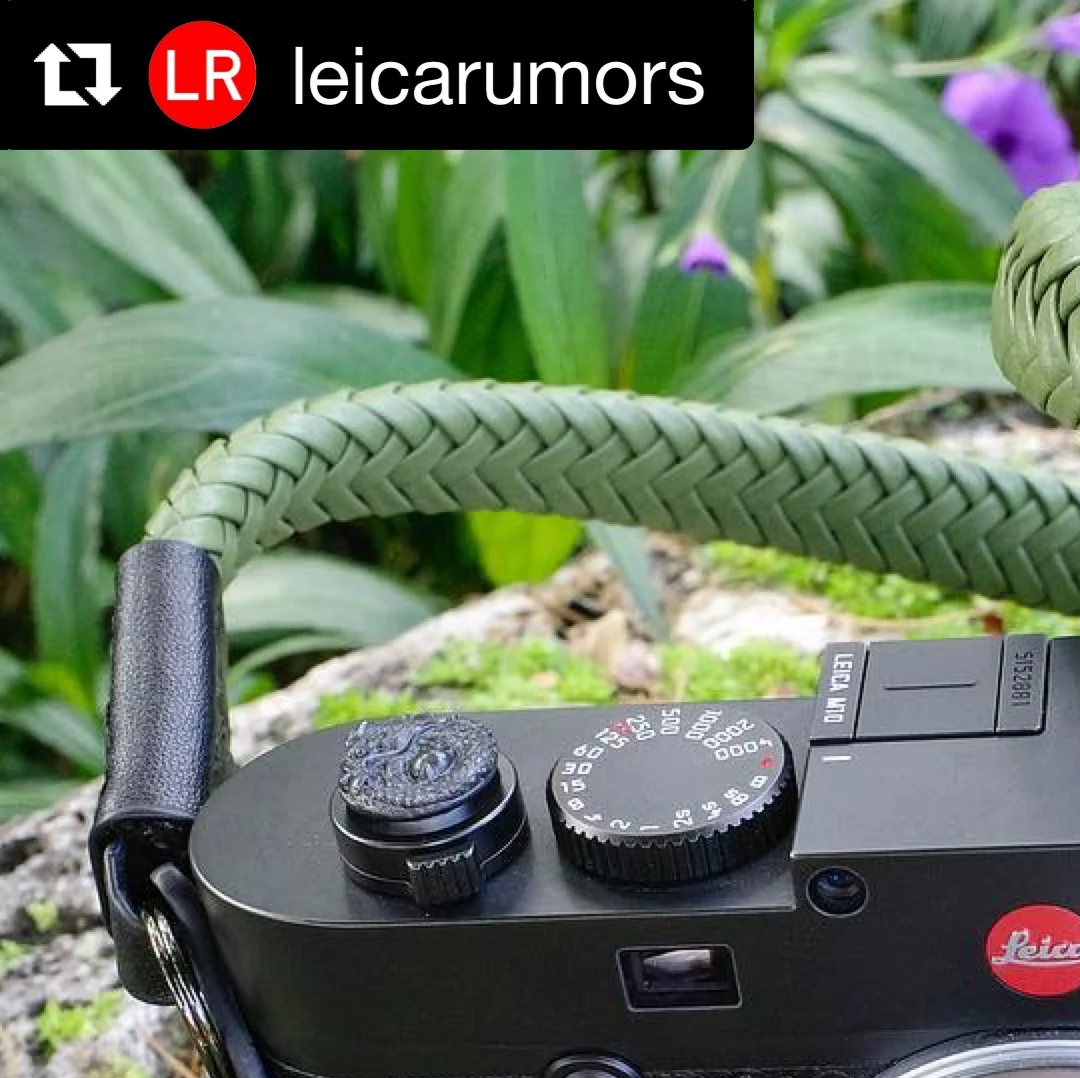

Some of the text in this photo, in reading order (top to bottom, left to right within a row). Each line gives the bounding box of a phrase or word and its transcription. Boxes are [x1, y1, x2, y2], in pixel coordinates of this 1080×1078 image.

[823, 653, 854, 723] LEICA M10
[626, 714, 656, 741] 250
[660, 707, 681, 735] 500
[686, 708, 723, 741] 1000
[703, 717, 755, 749] 2000
[573, 744, 604, 759] 60
[715, 737, 773, 761] 4000
[561, 762, 593, 775] 30
[559, 779, 586, 793] 15
[610, 819, 631, 830] 2
